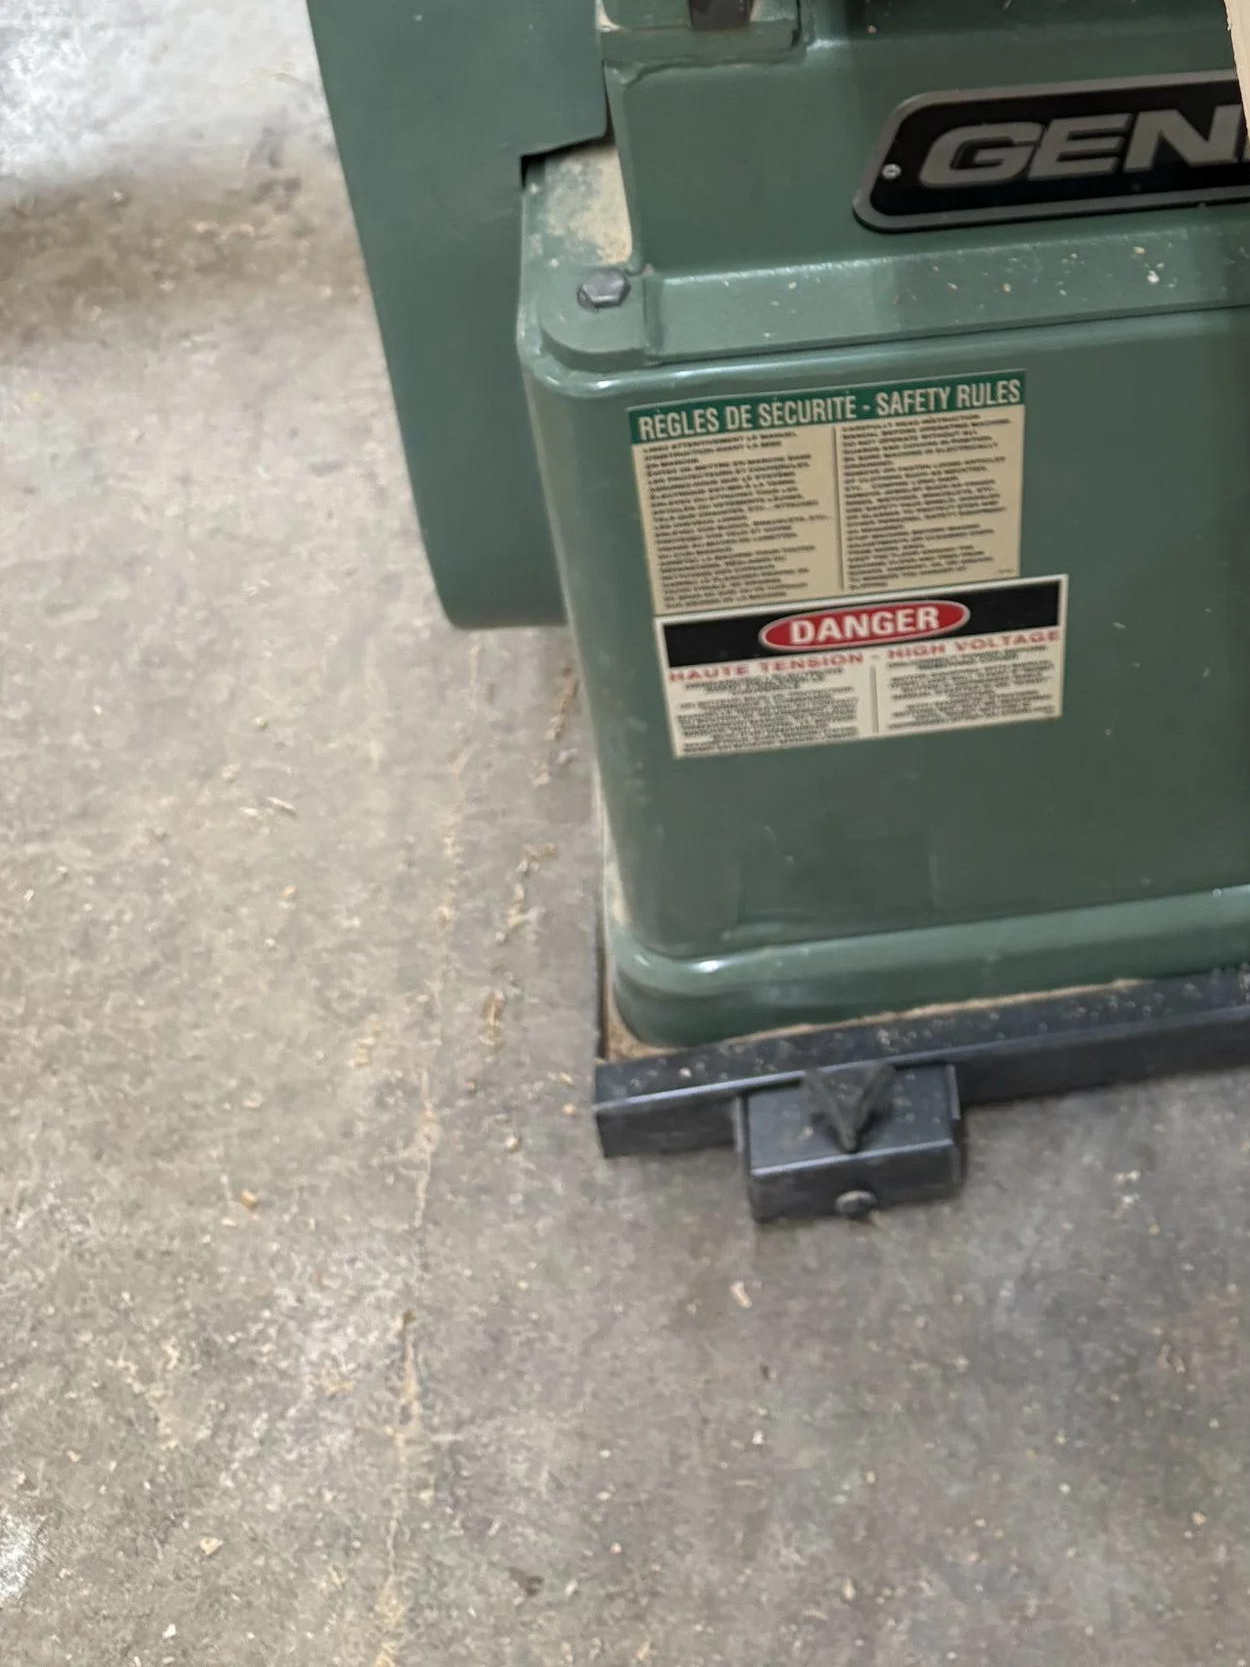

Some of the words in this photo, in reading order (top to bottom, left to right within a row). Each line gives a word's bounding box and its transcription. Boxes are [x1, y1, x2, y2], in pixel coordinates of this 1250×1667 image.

[724, 404, 754, 430] DE
[876, 385, 951, 416] SAFETY
[955, 378, 1021, 408] RULES
[789, 604, 940, 646] DANGER
[668, 665, 751, 682] HAUTE
[756, 652, 865, 673] TENSION
[887, 643, 946, 660] HIGH
[953, 630, 1062, 652] VOLTAGE
